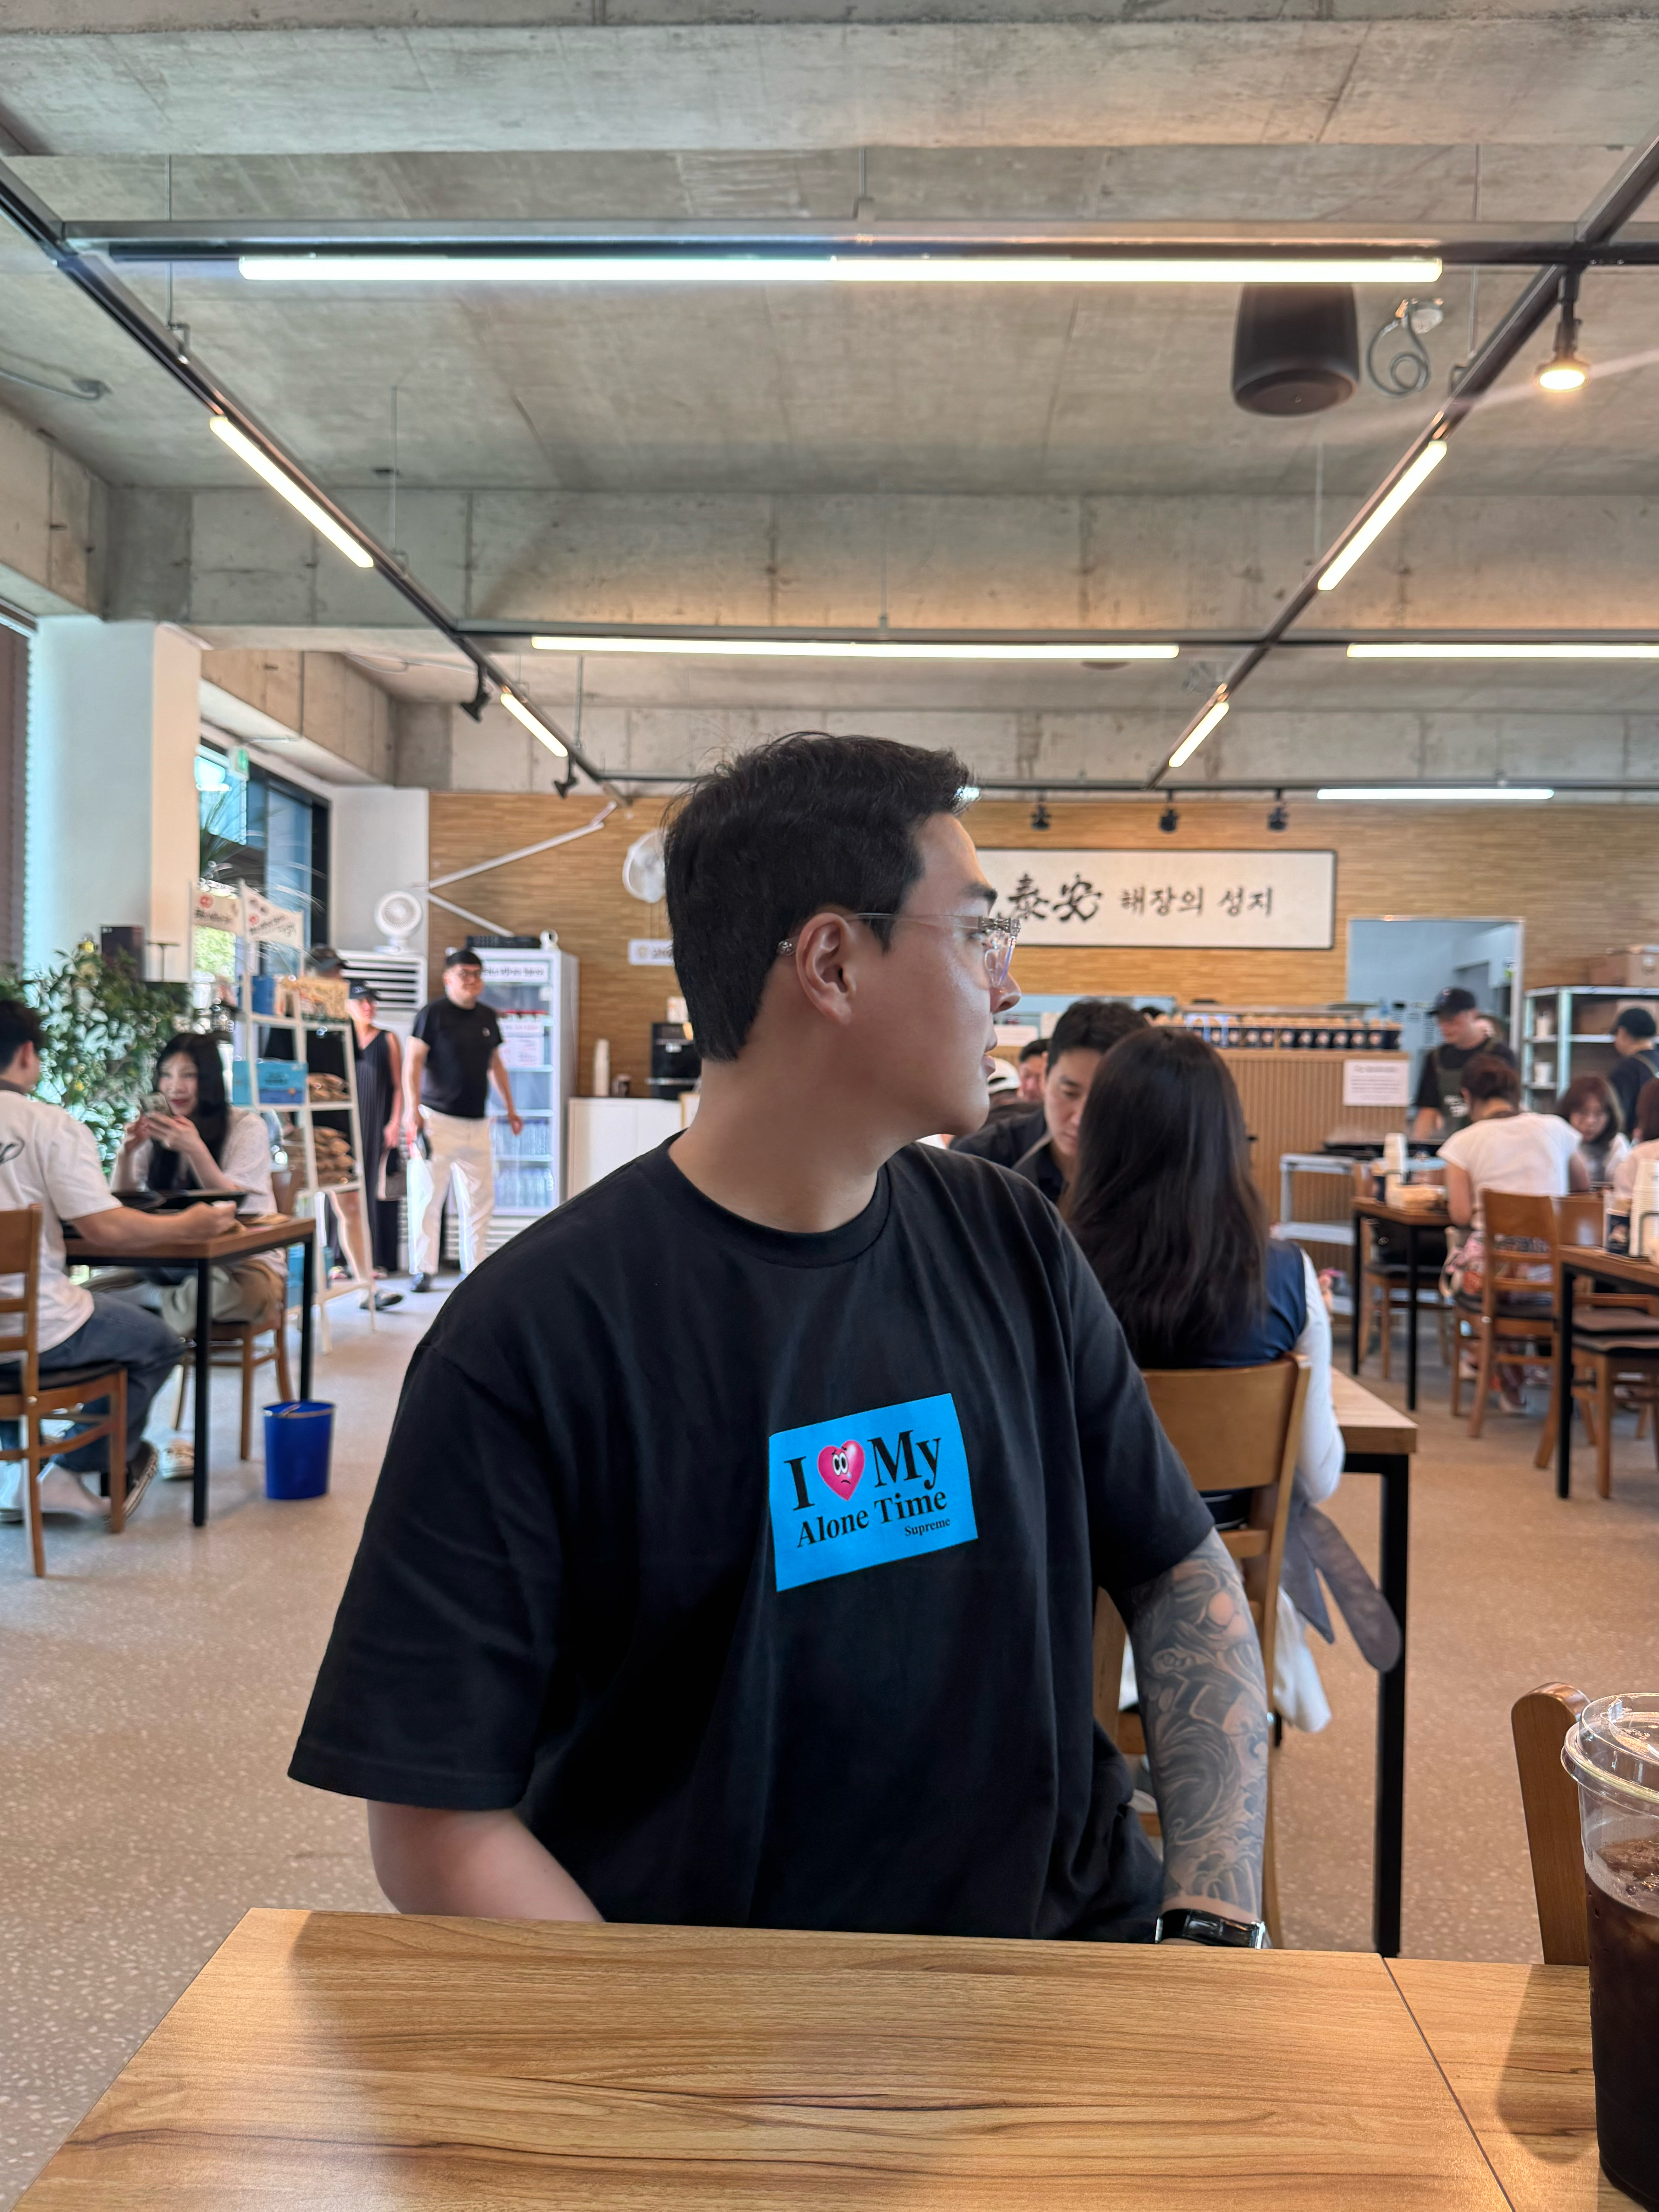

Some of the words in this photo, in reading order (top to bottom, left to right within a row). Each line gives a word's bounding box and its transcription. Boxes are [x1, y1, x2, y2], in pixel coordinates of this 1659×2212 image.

[1121, 886, 1204, 917] 해장의
[1217, 887, 1273, 917] 성지
[783, 1456, 815, 1511] I
[867, 1429, 941, 1490] My
[796, 1510, 869, 1548] Alone
[874, 1491, 947, 1525] Time
[904, 1518, 951, 1537] Supreme
